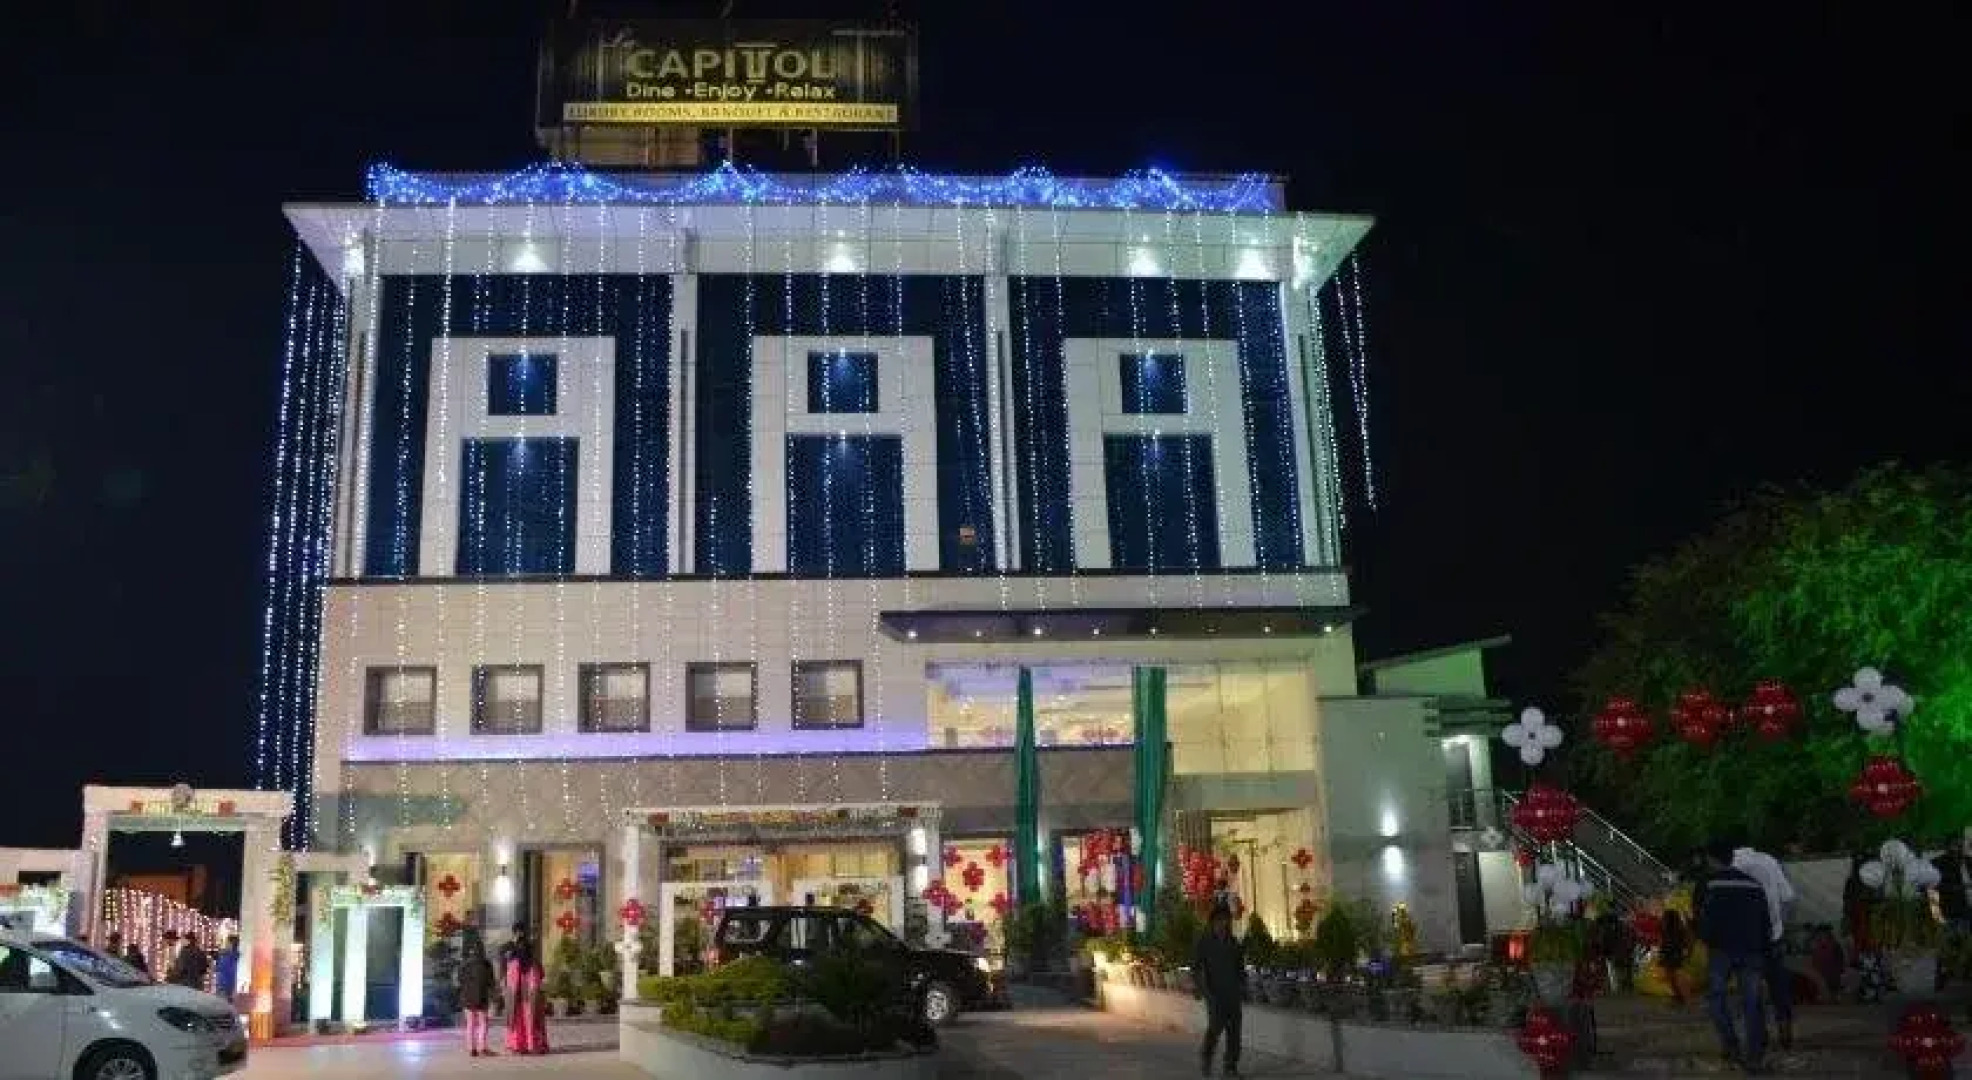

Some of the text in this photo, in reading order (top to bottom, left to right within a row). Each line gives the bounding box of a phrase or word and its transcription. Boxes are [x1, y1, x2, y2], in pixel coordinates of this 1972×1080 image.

[628, 42, 838, 81] CAPITOL
[627, 81, 836, 101] Dine Enjoy Relax
